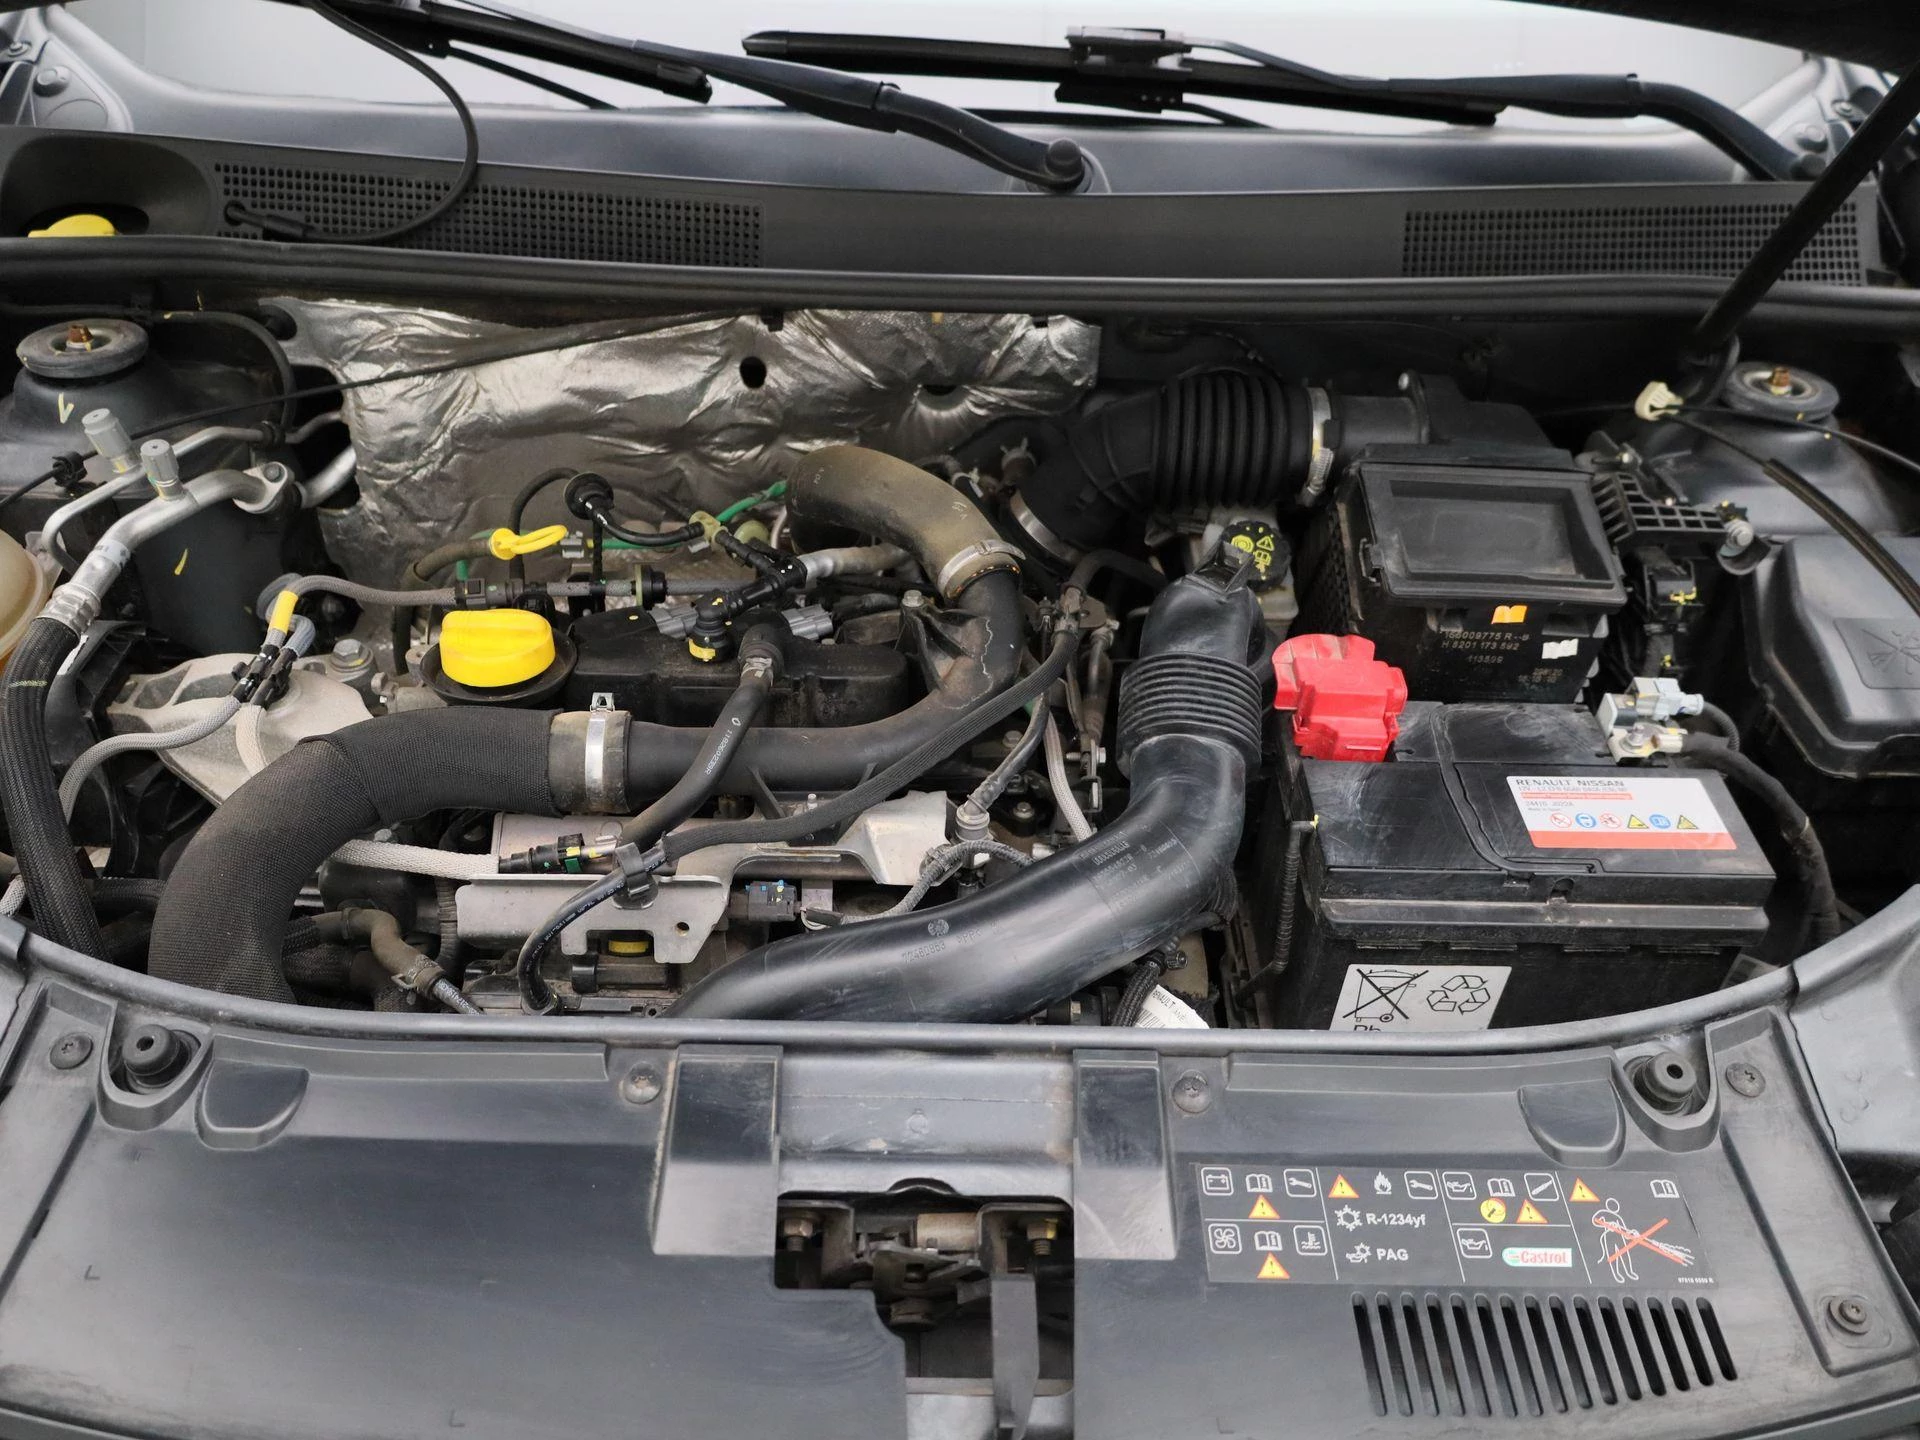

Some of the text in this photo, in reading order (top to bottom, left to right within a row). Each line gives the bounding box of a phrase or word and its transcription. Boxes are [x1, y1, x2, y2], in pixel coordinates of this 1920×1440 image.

[1366, 1213, 1426, 1228] R-1234yf
[1376, 1248, 1409, 1261] PAG
[1521, 1250, 1568, 1264] Castrol
